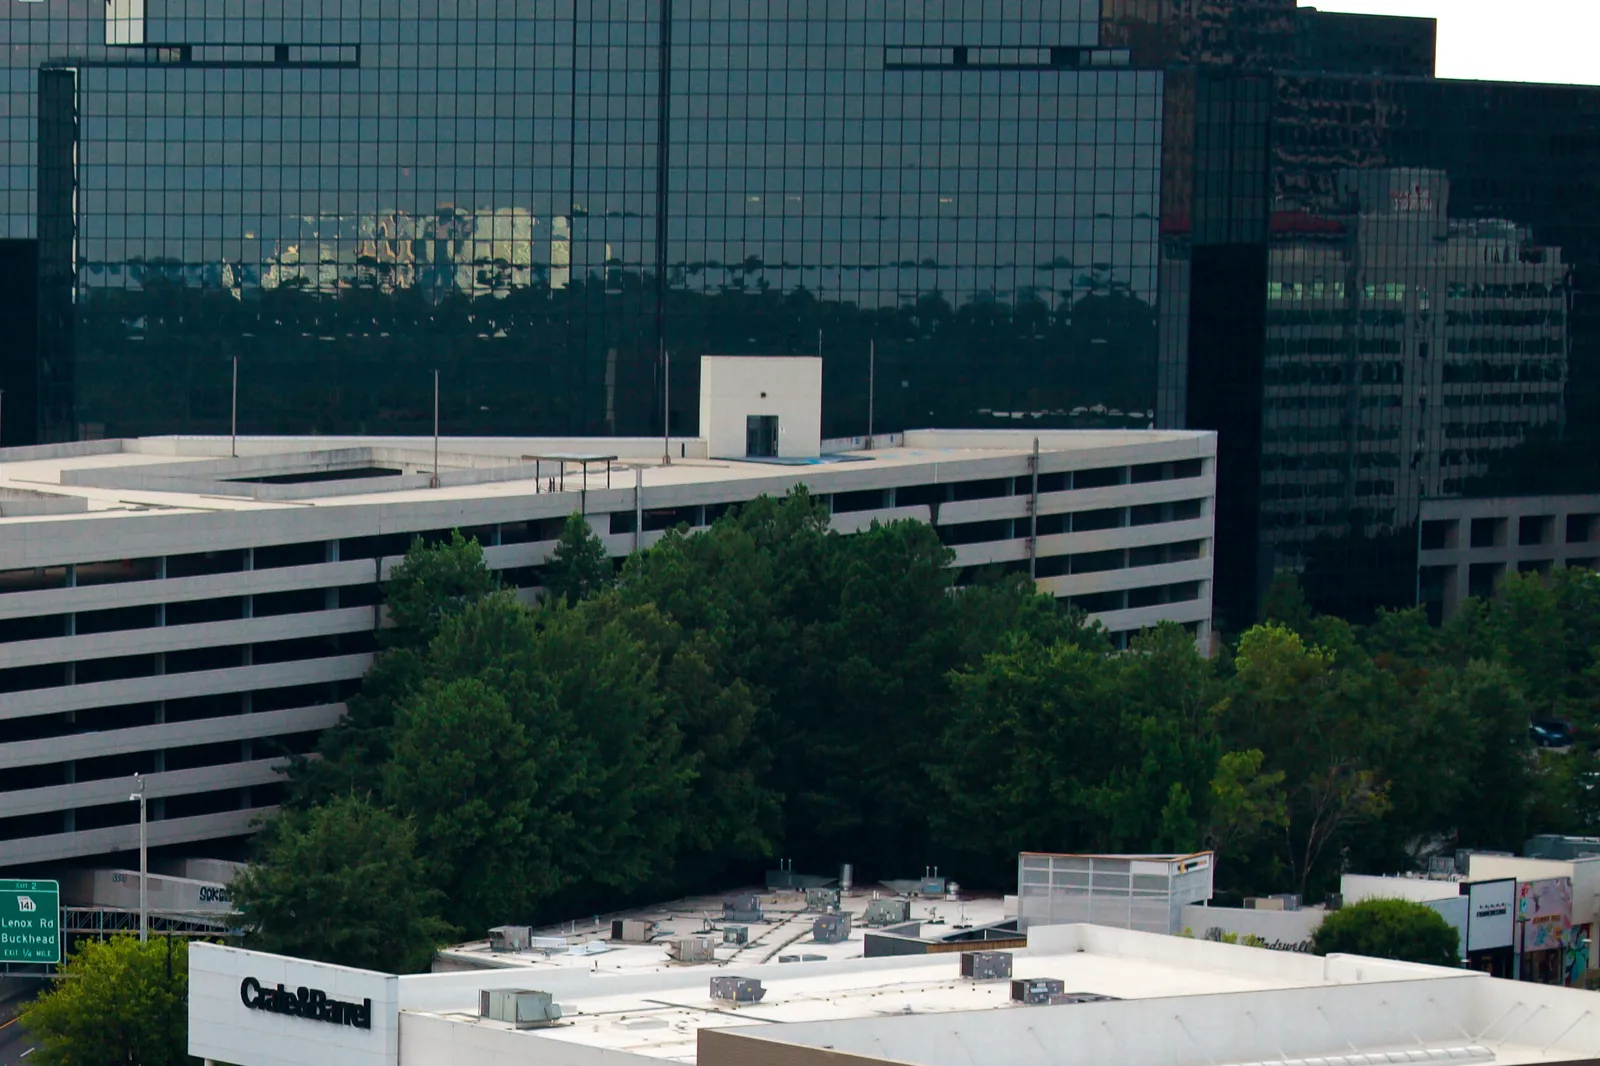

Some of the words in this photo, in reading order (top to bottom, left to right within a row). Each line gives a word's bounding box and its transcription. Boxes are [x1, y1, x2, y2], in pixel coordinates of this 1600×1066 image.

[31, 882, 37, 890] 2
[20, 901, 33, 911] 141
[1, 917, 33, 928] Lenox
[40, 918, 54, 928] Rd
[1, 932, 55, 944] Buckhead
[4, 949, 18, 957] EXIT
[240, 976, 371, 1030] Crate&Barrel
